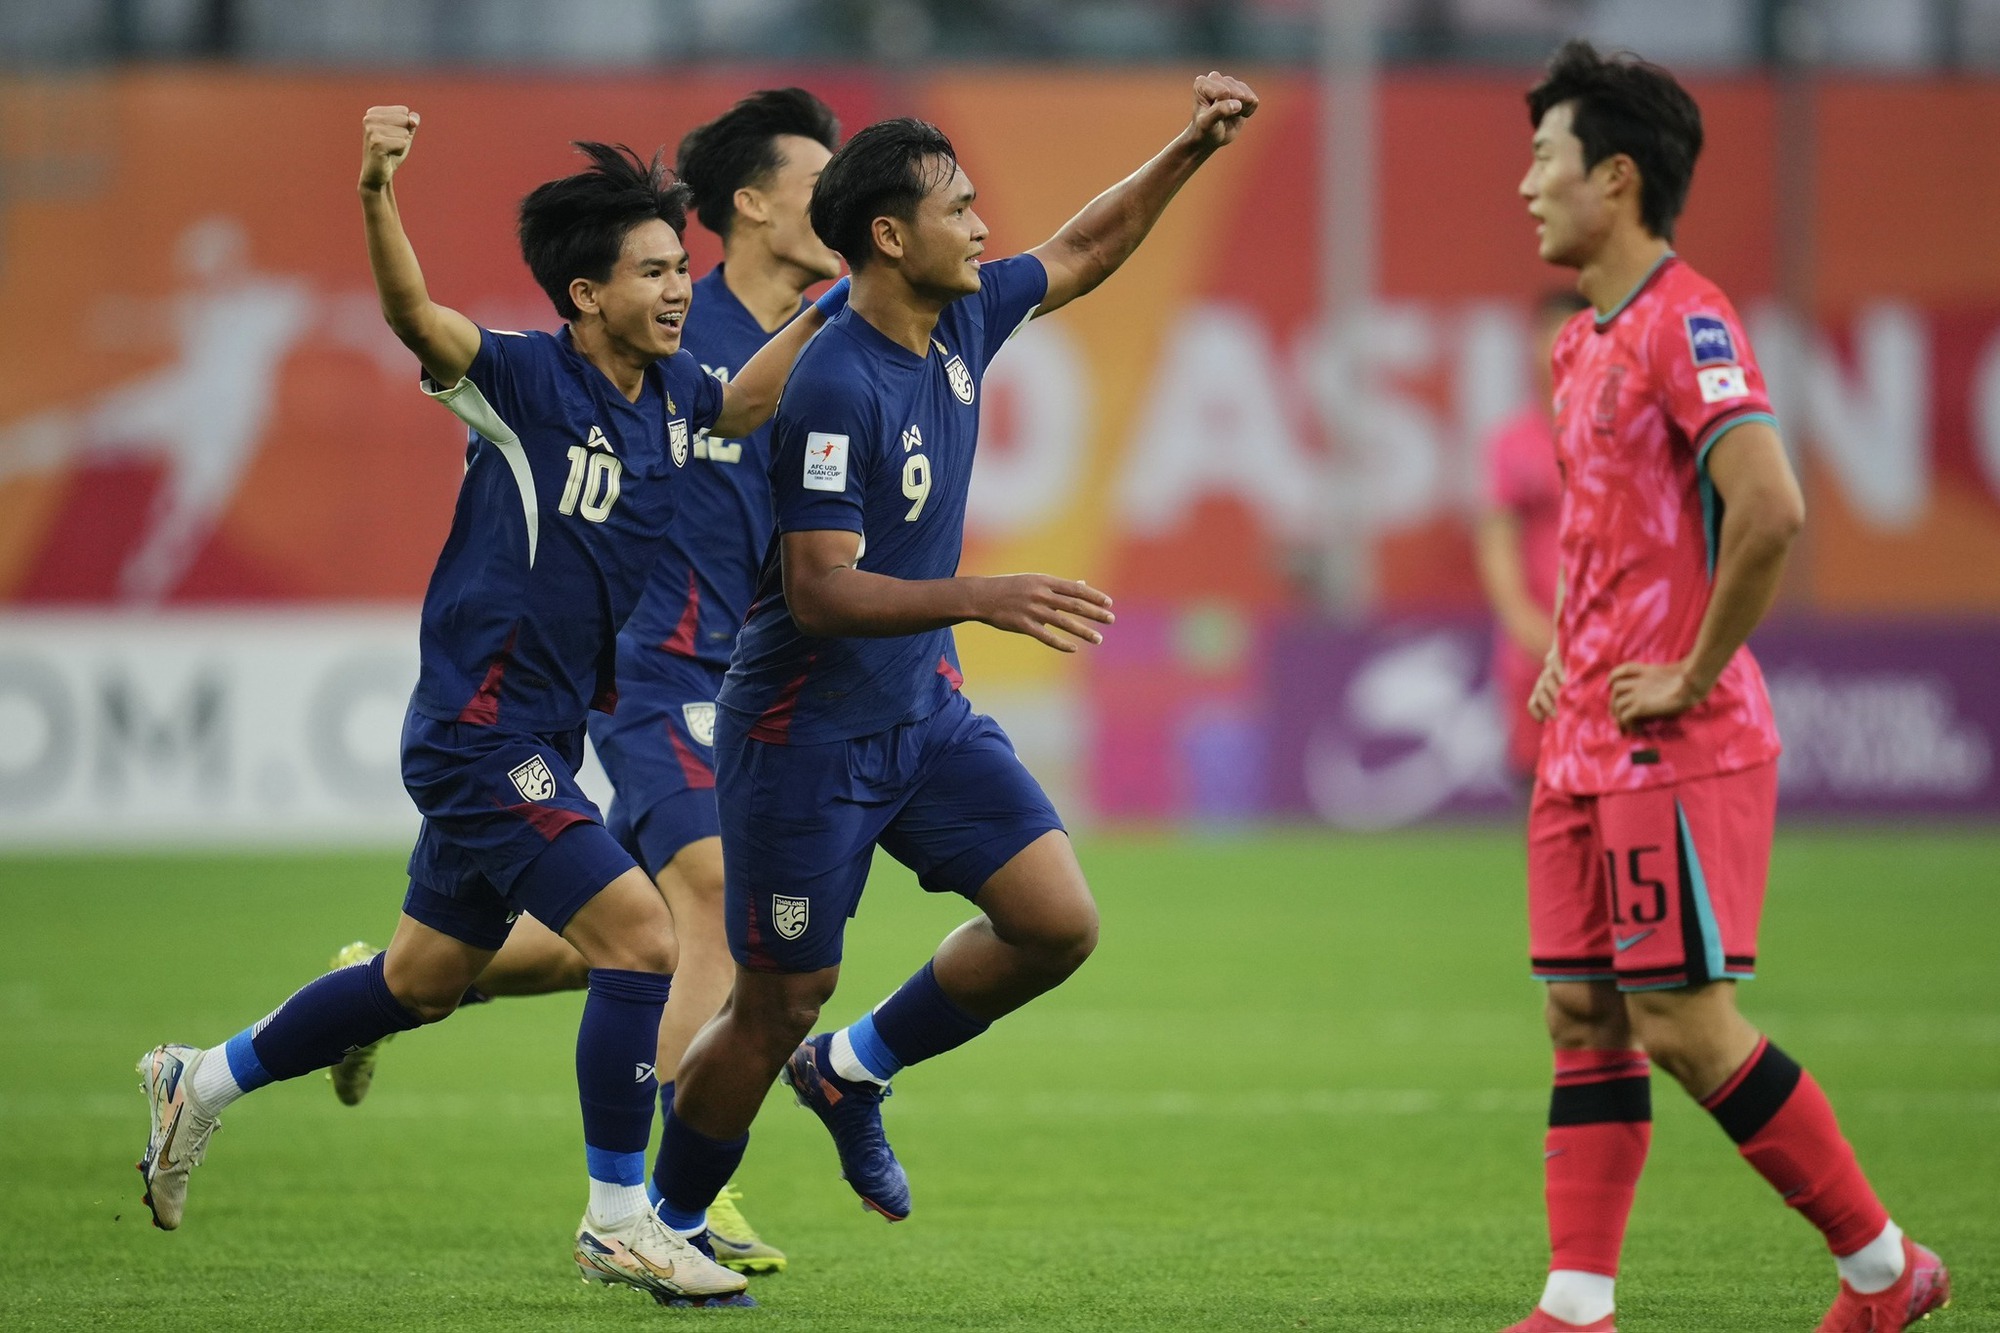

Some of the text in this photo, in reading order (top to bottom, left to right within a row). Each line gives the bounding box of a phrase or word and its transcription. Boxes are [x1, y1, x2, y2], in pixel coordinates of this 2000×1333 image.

[1112, 300, 1930, 535] ASIN
[558, 445, 622, 523] 10
[902, 453, 932, 522] 9
[513, 760, 540, 779] THAILAND
[776, 898, 806, 907] THAILAND
[1605, 846, 1667, 925] 15
